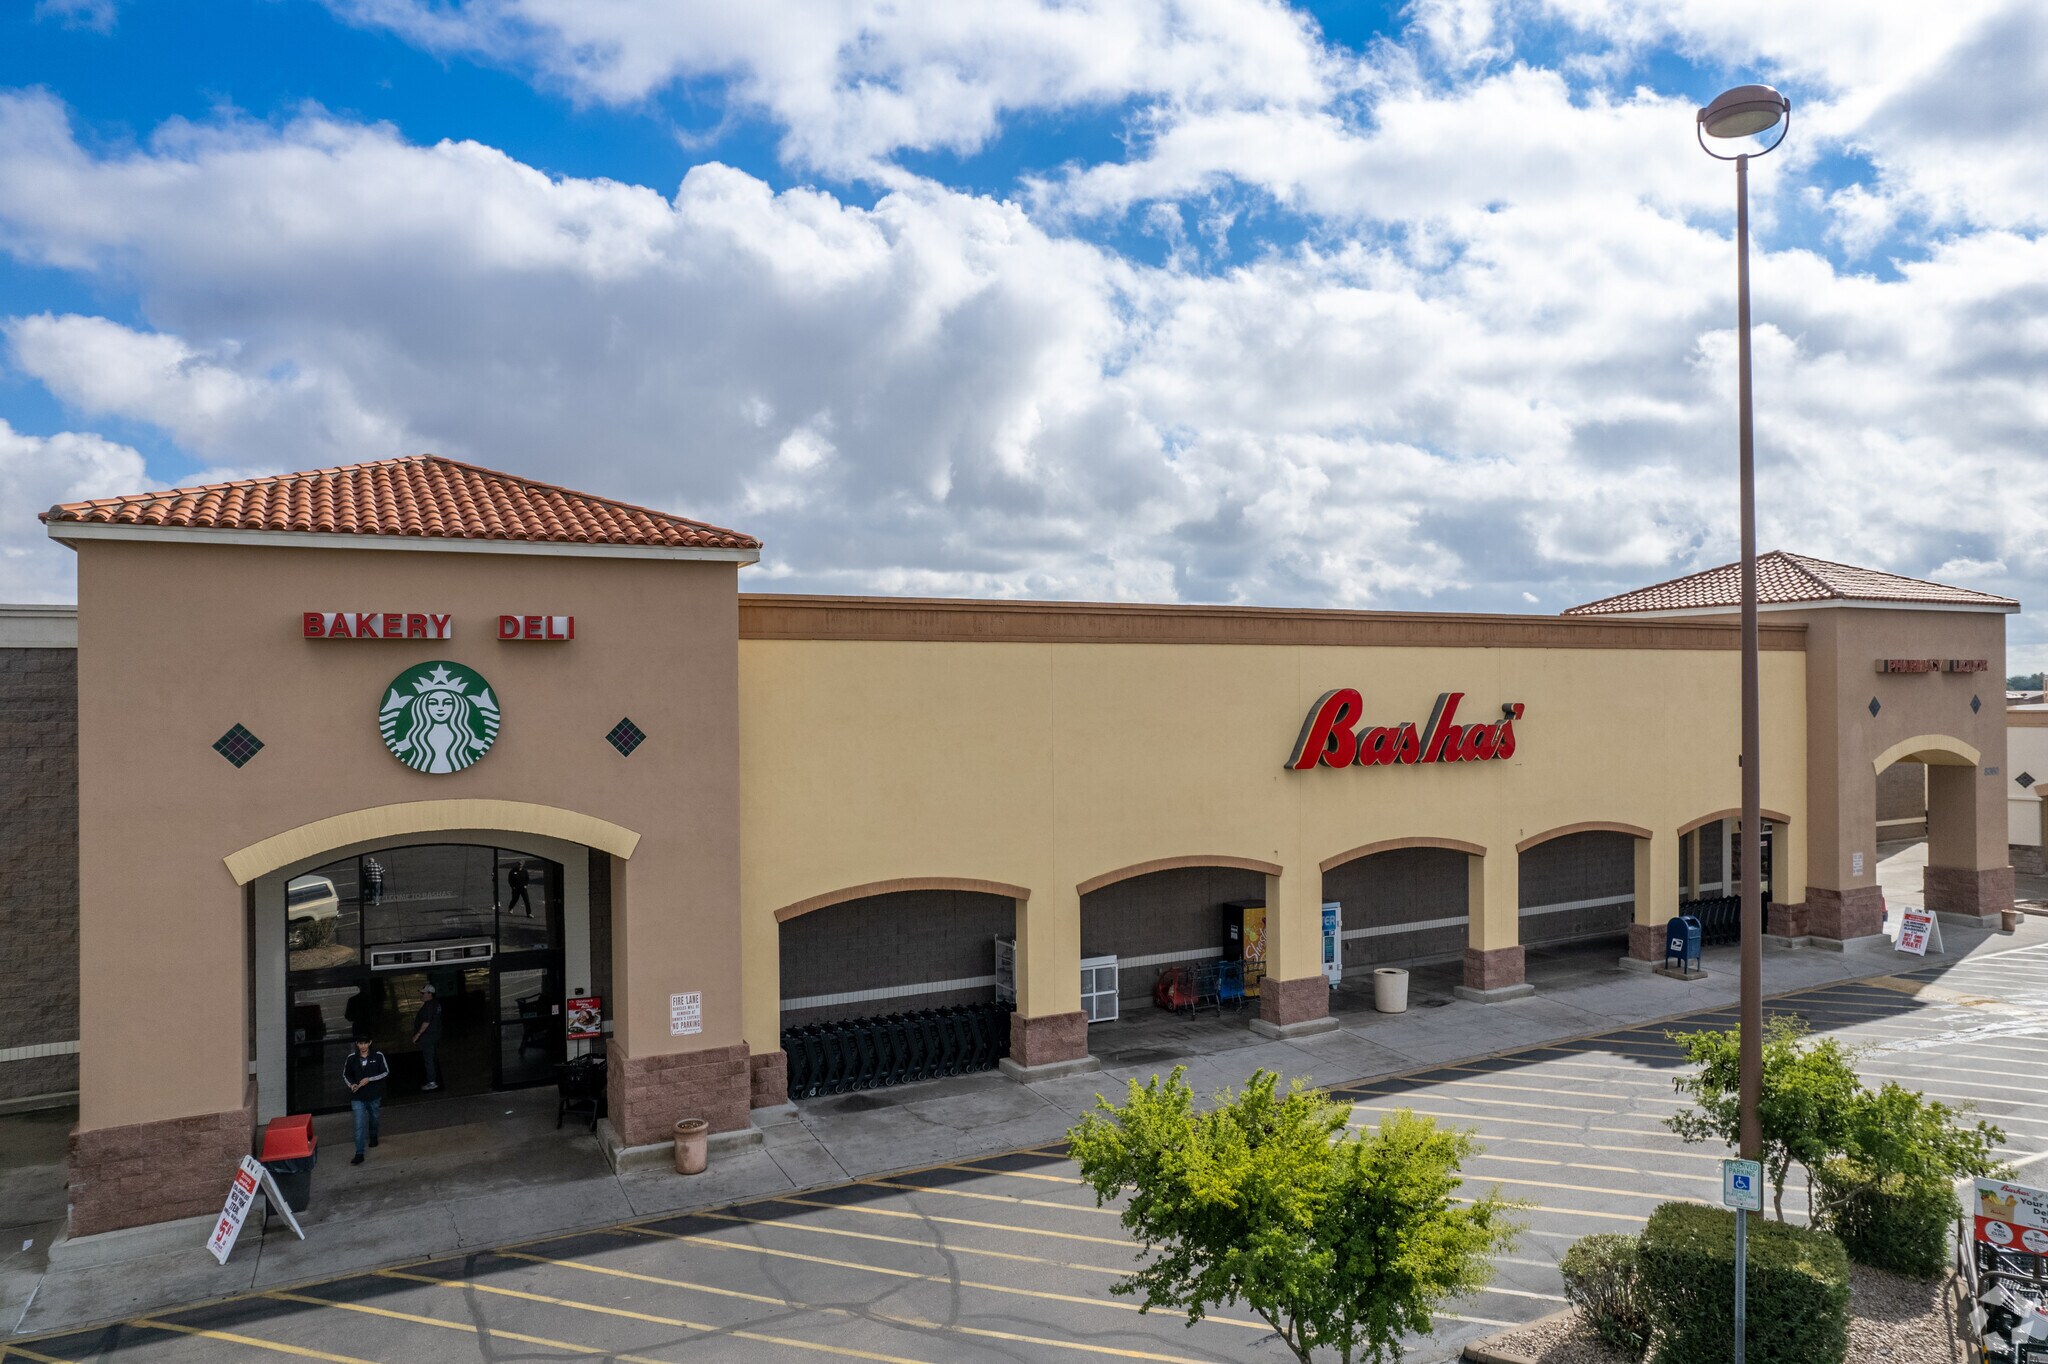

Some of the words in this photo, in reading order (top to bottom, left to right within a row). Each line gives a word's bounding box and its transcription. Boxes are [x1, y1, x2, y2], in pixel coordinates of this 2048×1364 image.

[303, 612, 451, 638] BAKERY
[498, 615, 575, 639] DELI
[1884, 659, 1940, 672] PHARMACY
[1951, 659, 1988, 672] LIQUOR
[672, 996, 684, 1006] FIRE
[685, 994, 699, 1005] LANE
[672, 1022, 679, 1030] NO
[680, 1019, 700, 1029] PARKING
[1726, 1160, 1757, 1172] RESERVED
[1729, 1167, 1756, 1178] PARKING
[2020, 1198, 2043, 1208] Your
